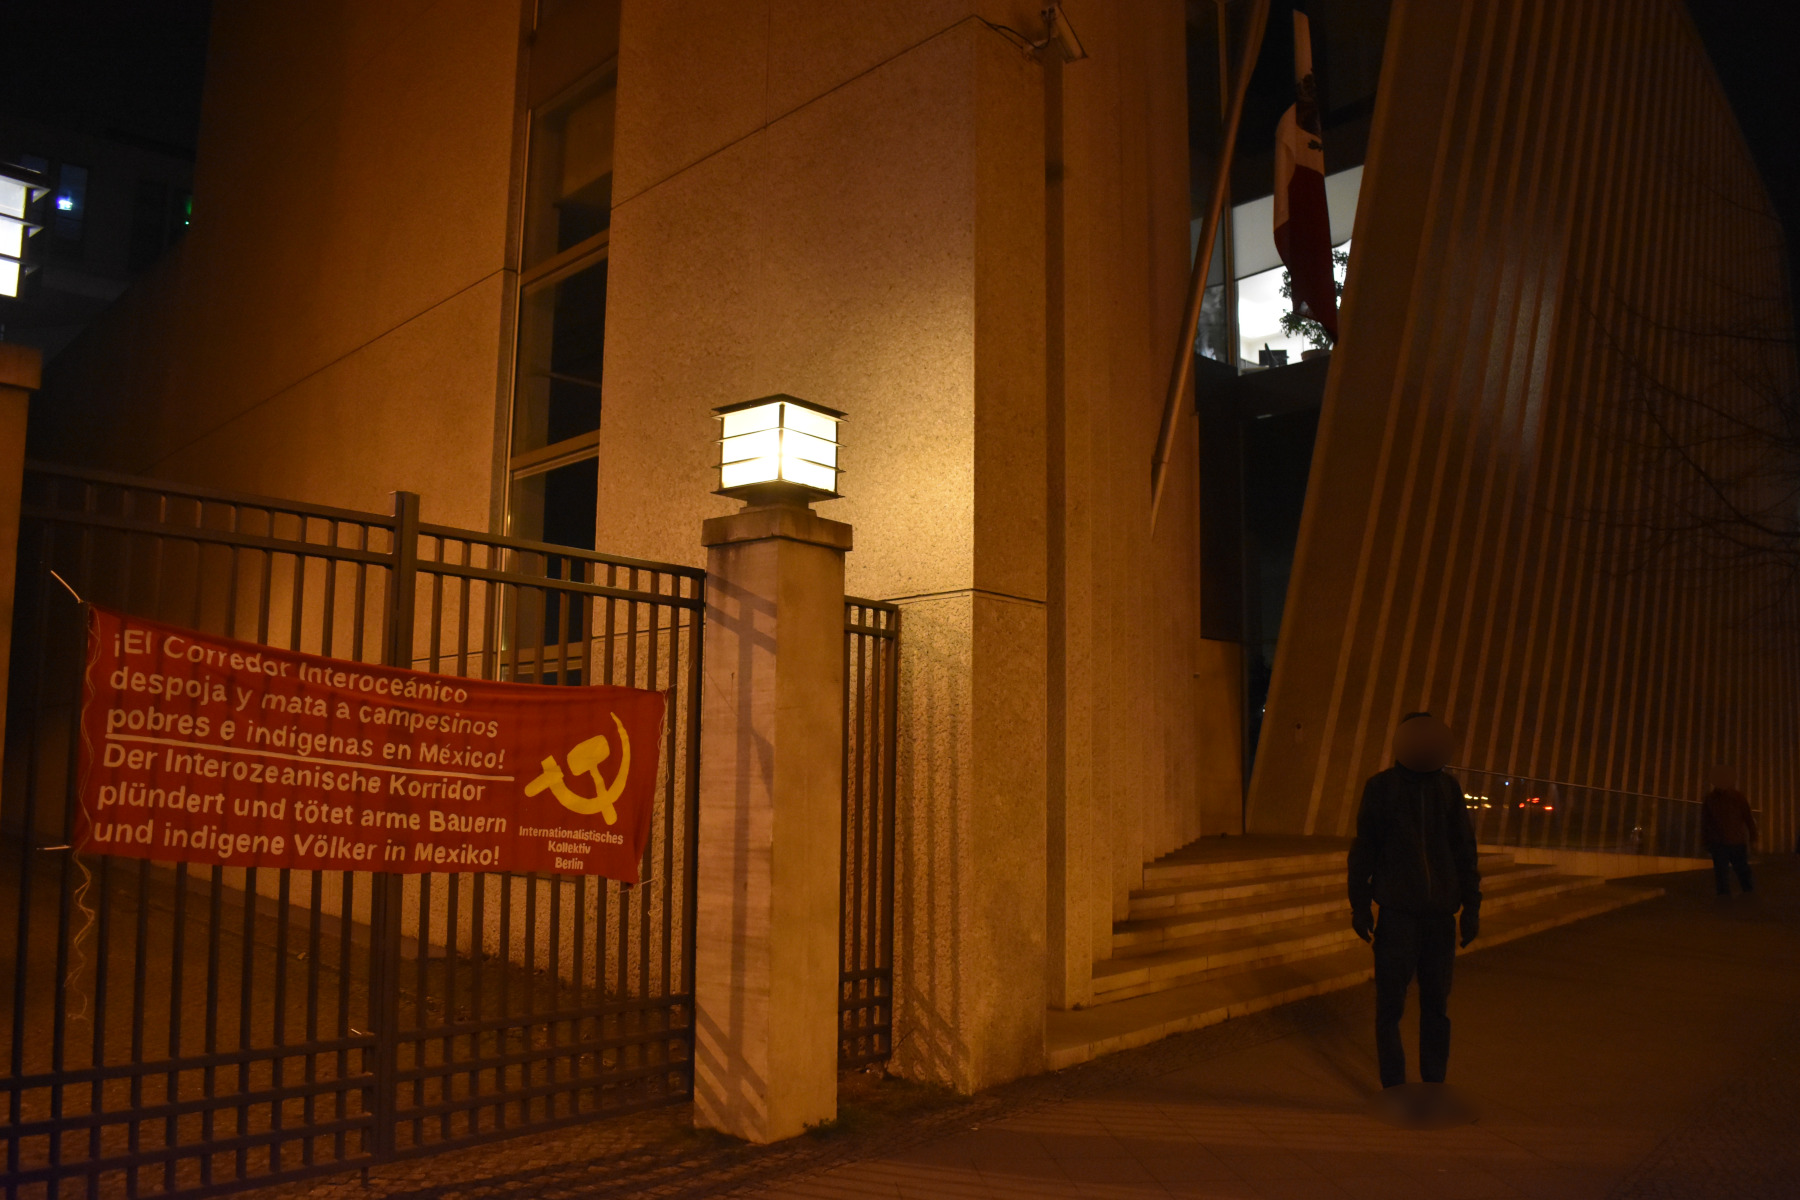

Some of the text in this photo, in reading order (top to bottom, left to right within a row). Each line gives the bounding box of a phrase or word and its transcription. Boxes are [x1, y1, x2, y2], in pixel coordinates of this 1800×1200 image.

[114, 629, 152, 658] ¡El
[163, 635, 291, 678] Corredor
[109, 666, 499, 739] despoja y mata a campesinos
[106, 706, 506, 770] pobres e indígenas en México!
[103, 742, 487, 801] Der Interozeanische Korridor
[97, 781, 507, 834] plündert und tötet arme Bauern
[94, 819, 500, 866] und indigene Völker in Mexiko!
[519, 825, 624, 845] Internationalistisches
[547, 840, 592, 855] Kollektiv
[554, 856, 584, 870] Berlin
